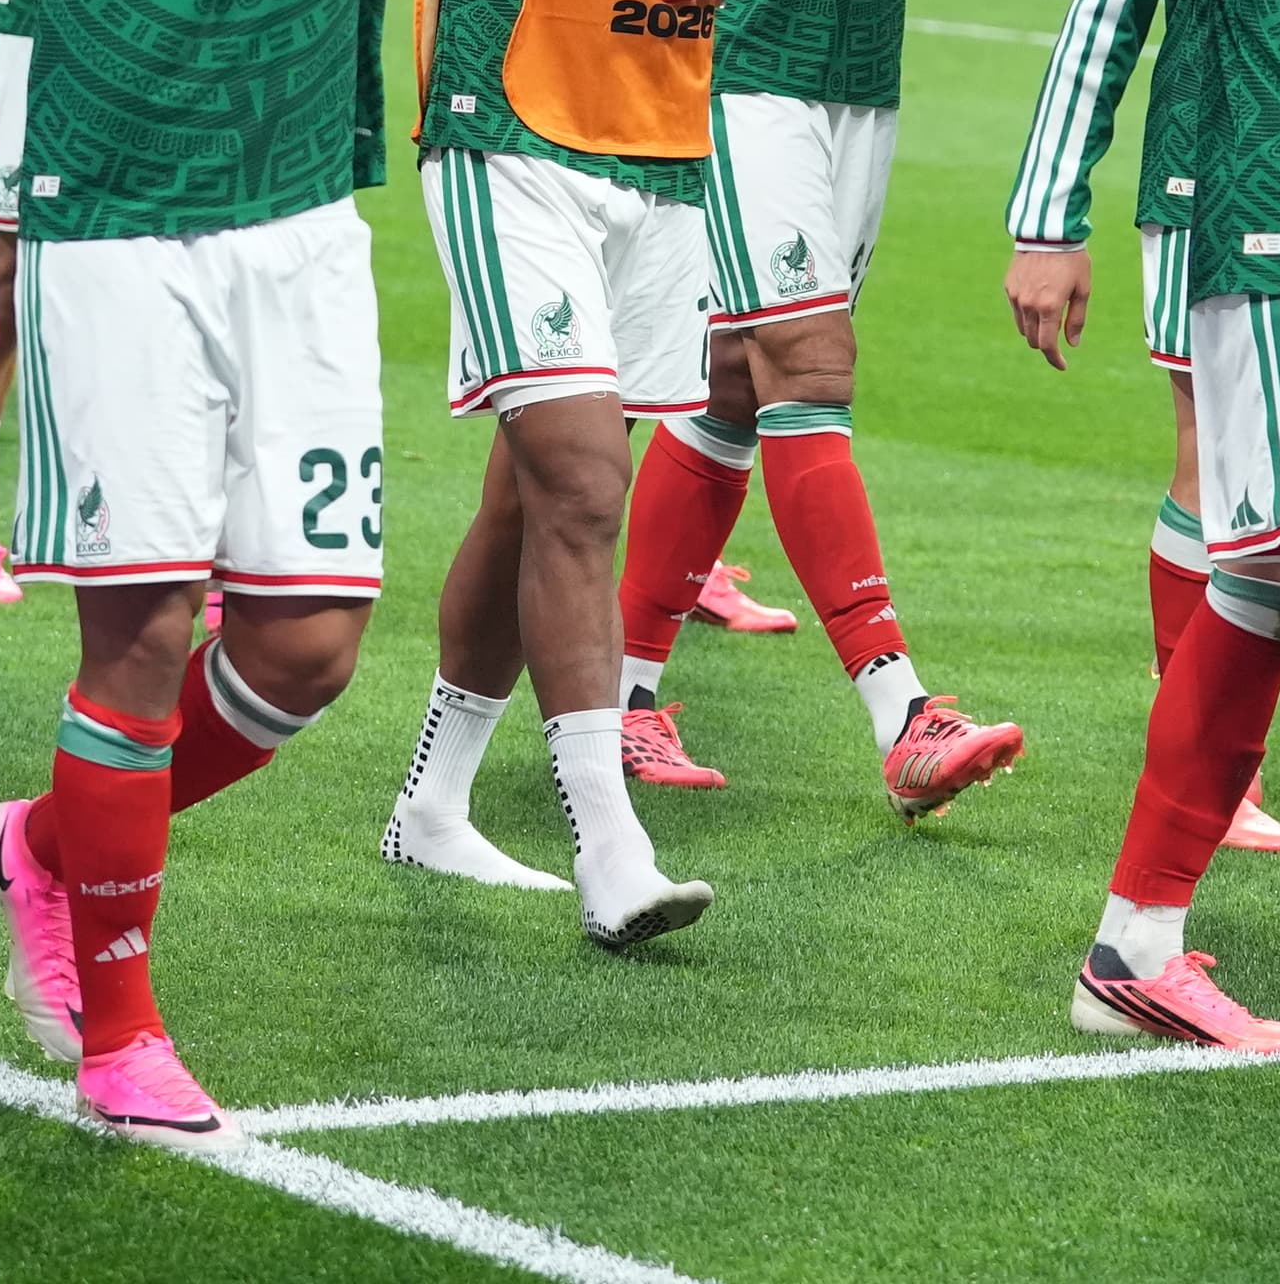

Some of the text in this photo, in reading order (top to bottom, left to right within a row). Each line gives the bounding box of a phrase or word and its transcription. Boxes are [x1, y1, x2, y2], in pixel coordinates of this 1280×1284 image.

[610, 0, 716, 40] 2026
[780, 280, 816, 294] MÉXICO
[540, 348, 581, 359] MÉXICO
[300, 447, 383, 548] 23
